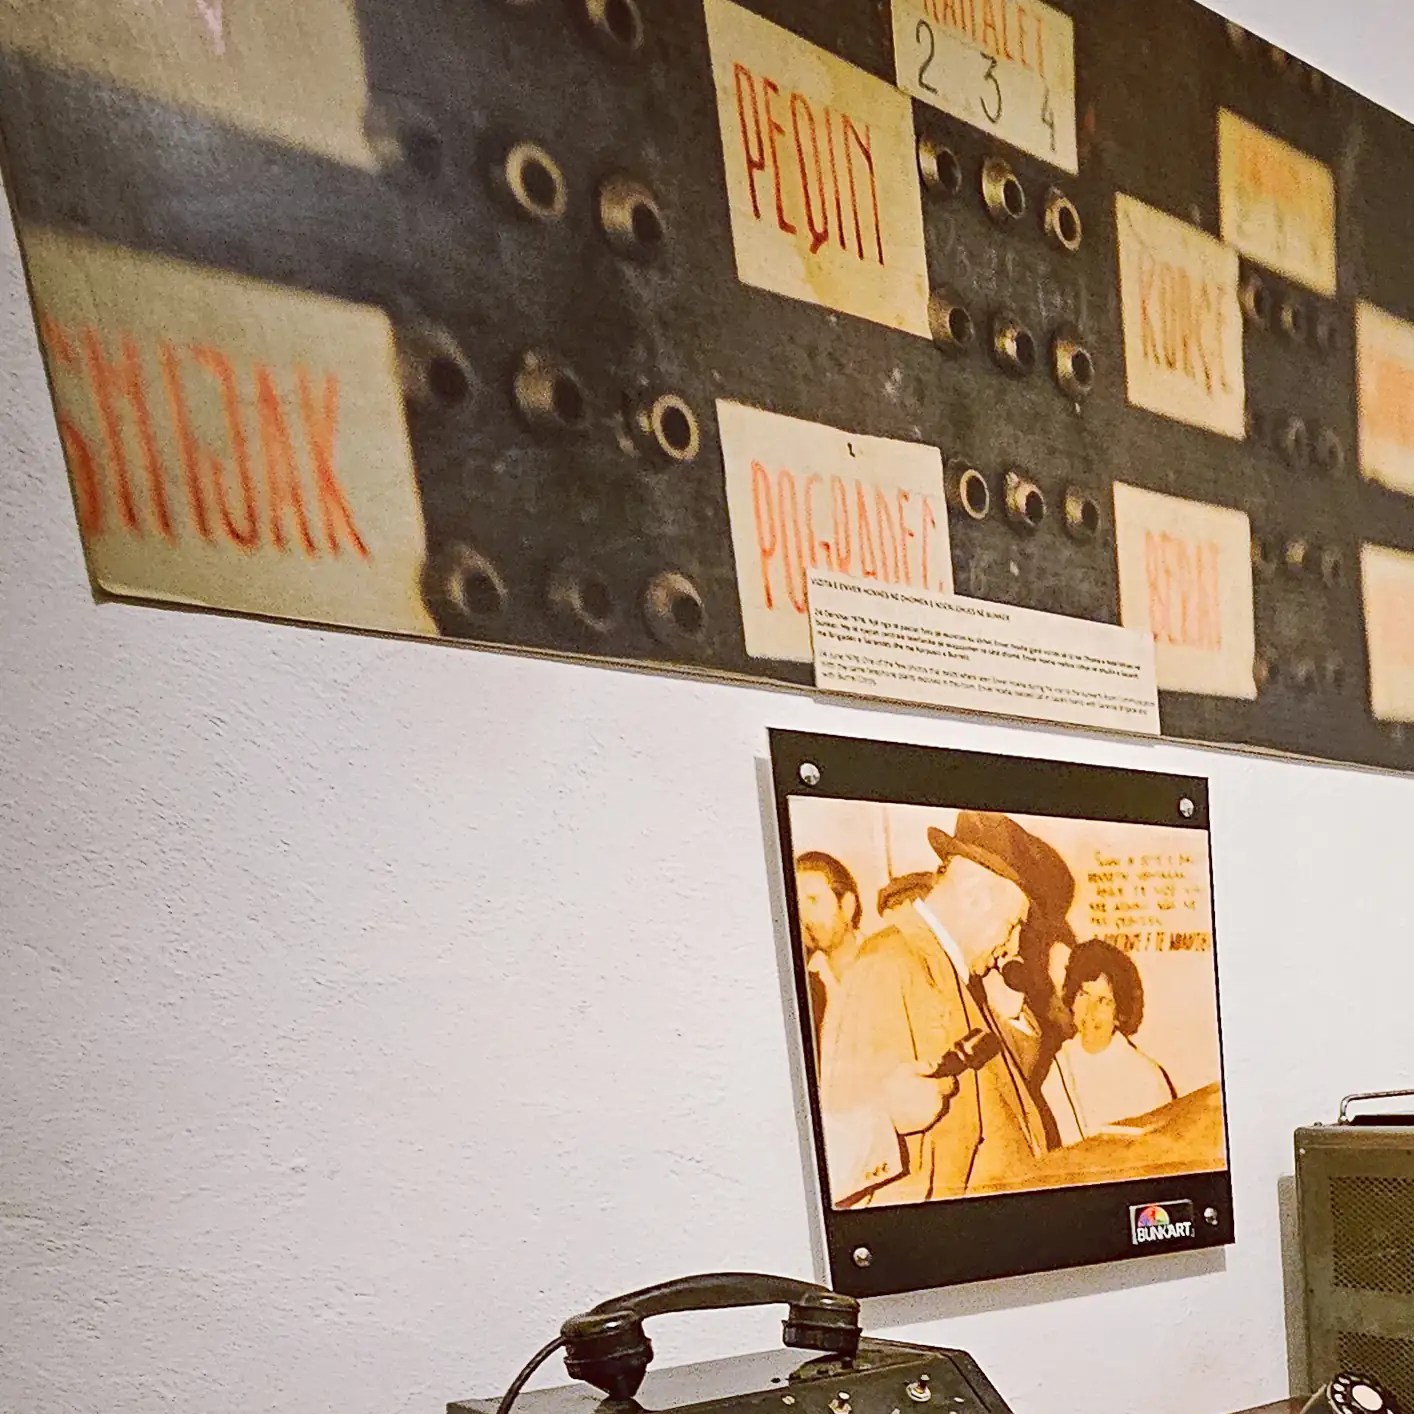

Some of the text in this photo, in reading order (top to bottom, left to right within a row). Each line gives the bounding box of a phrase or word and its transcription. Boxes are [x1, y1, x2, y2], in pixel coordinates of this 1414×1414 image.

[916, 18, 939, 95] 2
[979, 51, 1002, 124] 3
[733, 62, 885, 267] PEQIN
